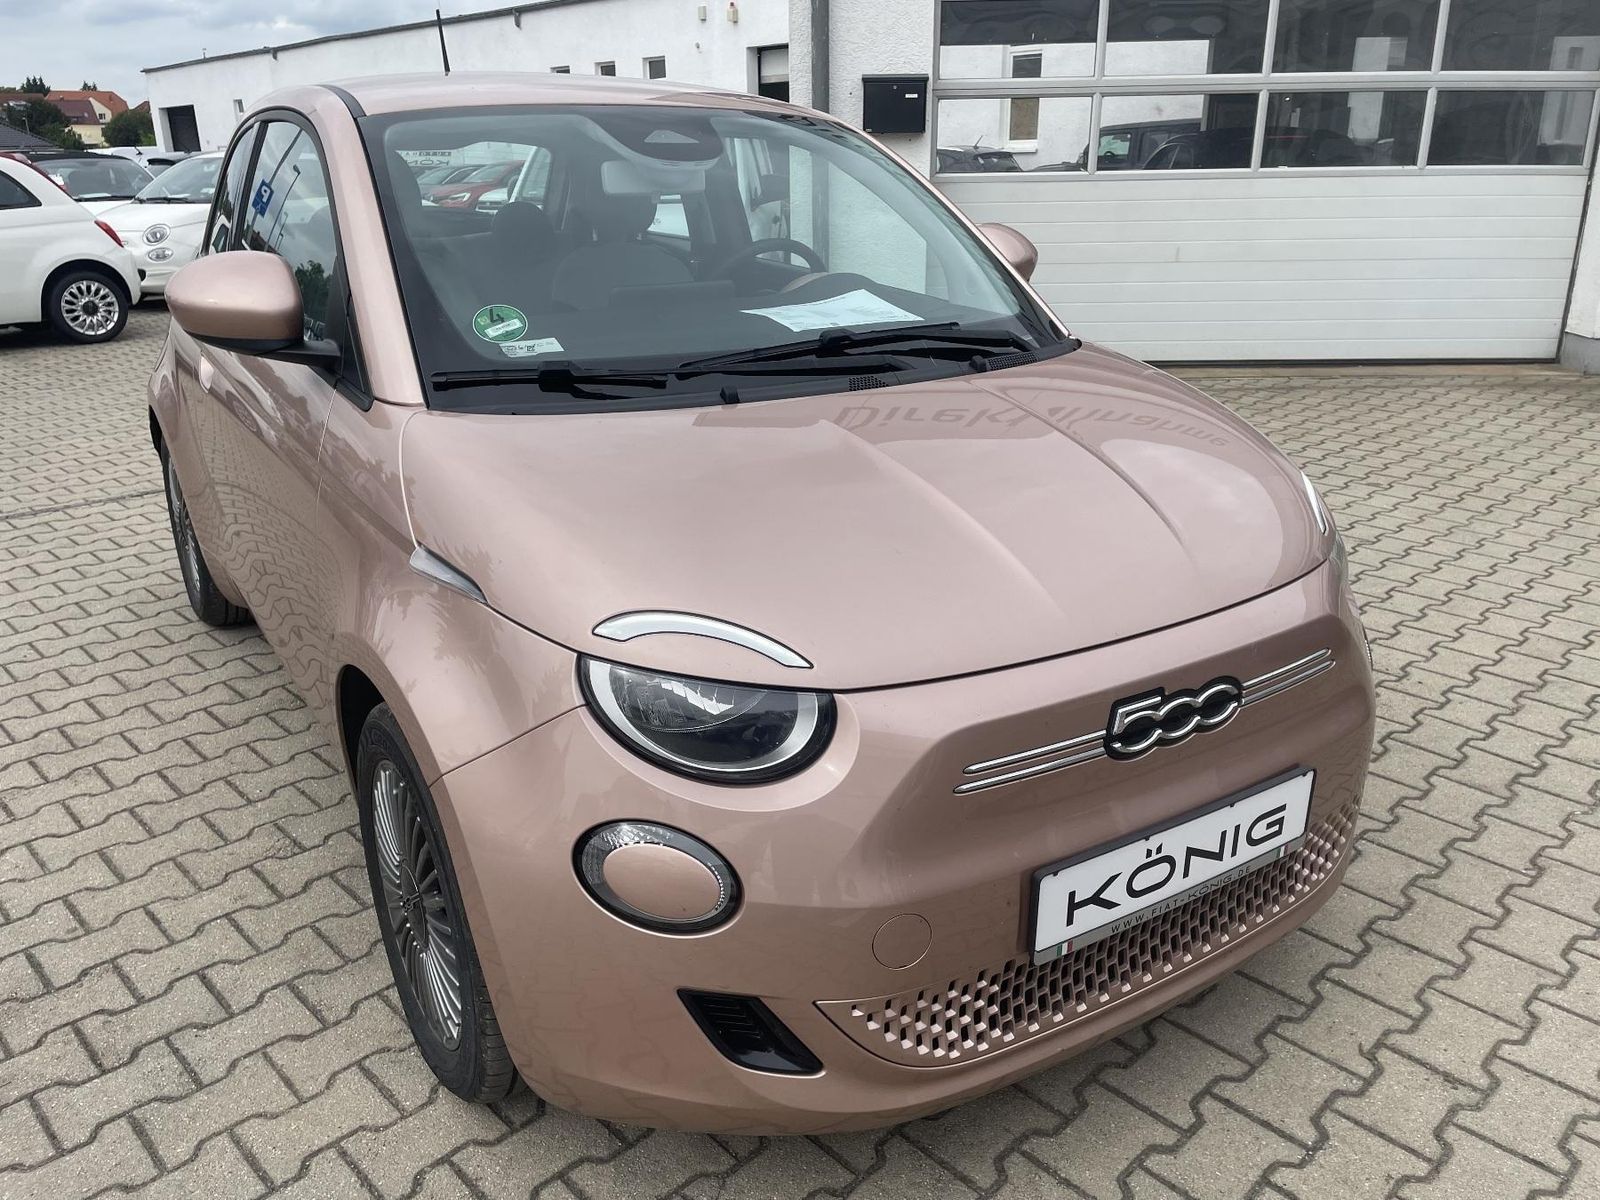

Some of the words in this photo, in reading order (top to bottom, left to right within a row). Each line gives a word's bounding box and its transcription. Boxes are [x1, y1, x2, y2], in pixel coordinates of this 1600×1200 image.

[1108, 682, 1240, 755] 500
[1065, 803, 1288, 928] KÖNIG
[1110, 864, 1251, 934] WWW.FIAT-KÖNIG.DE
